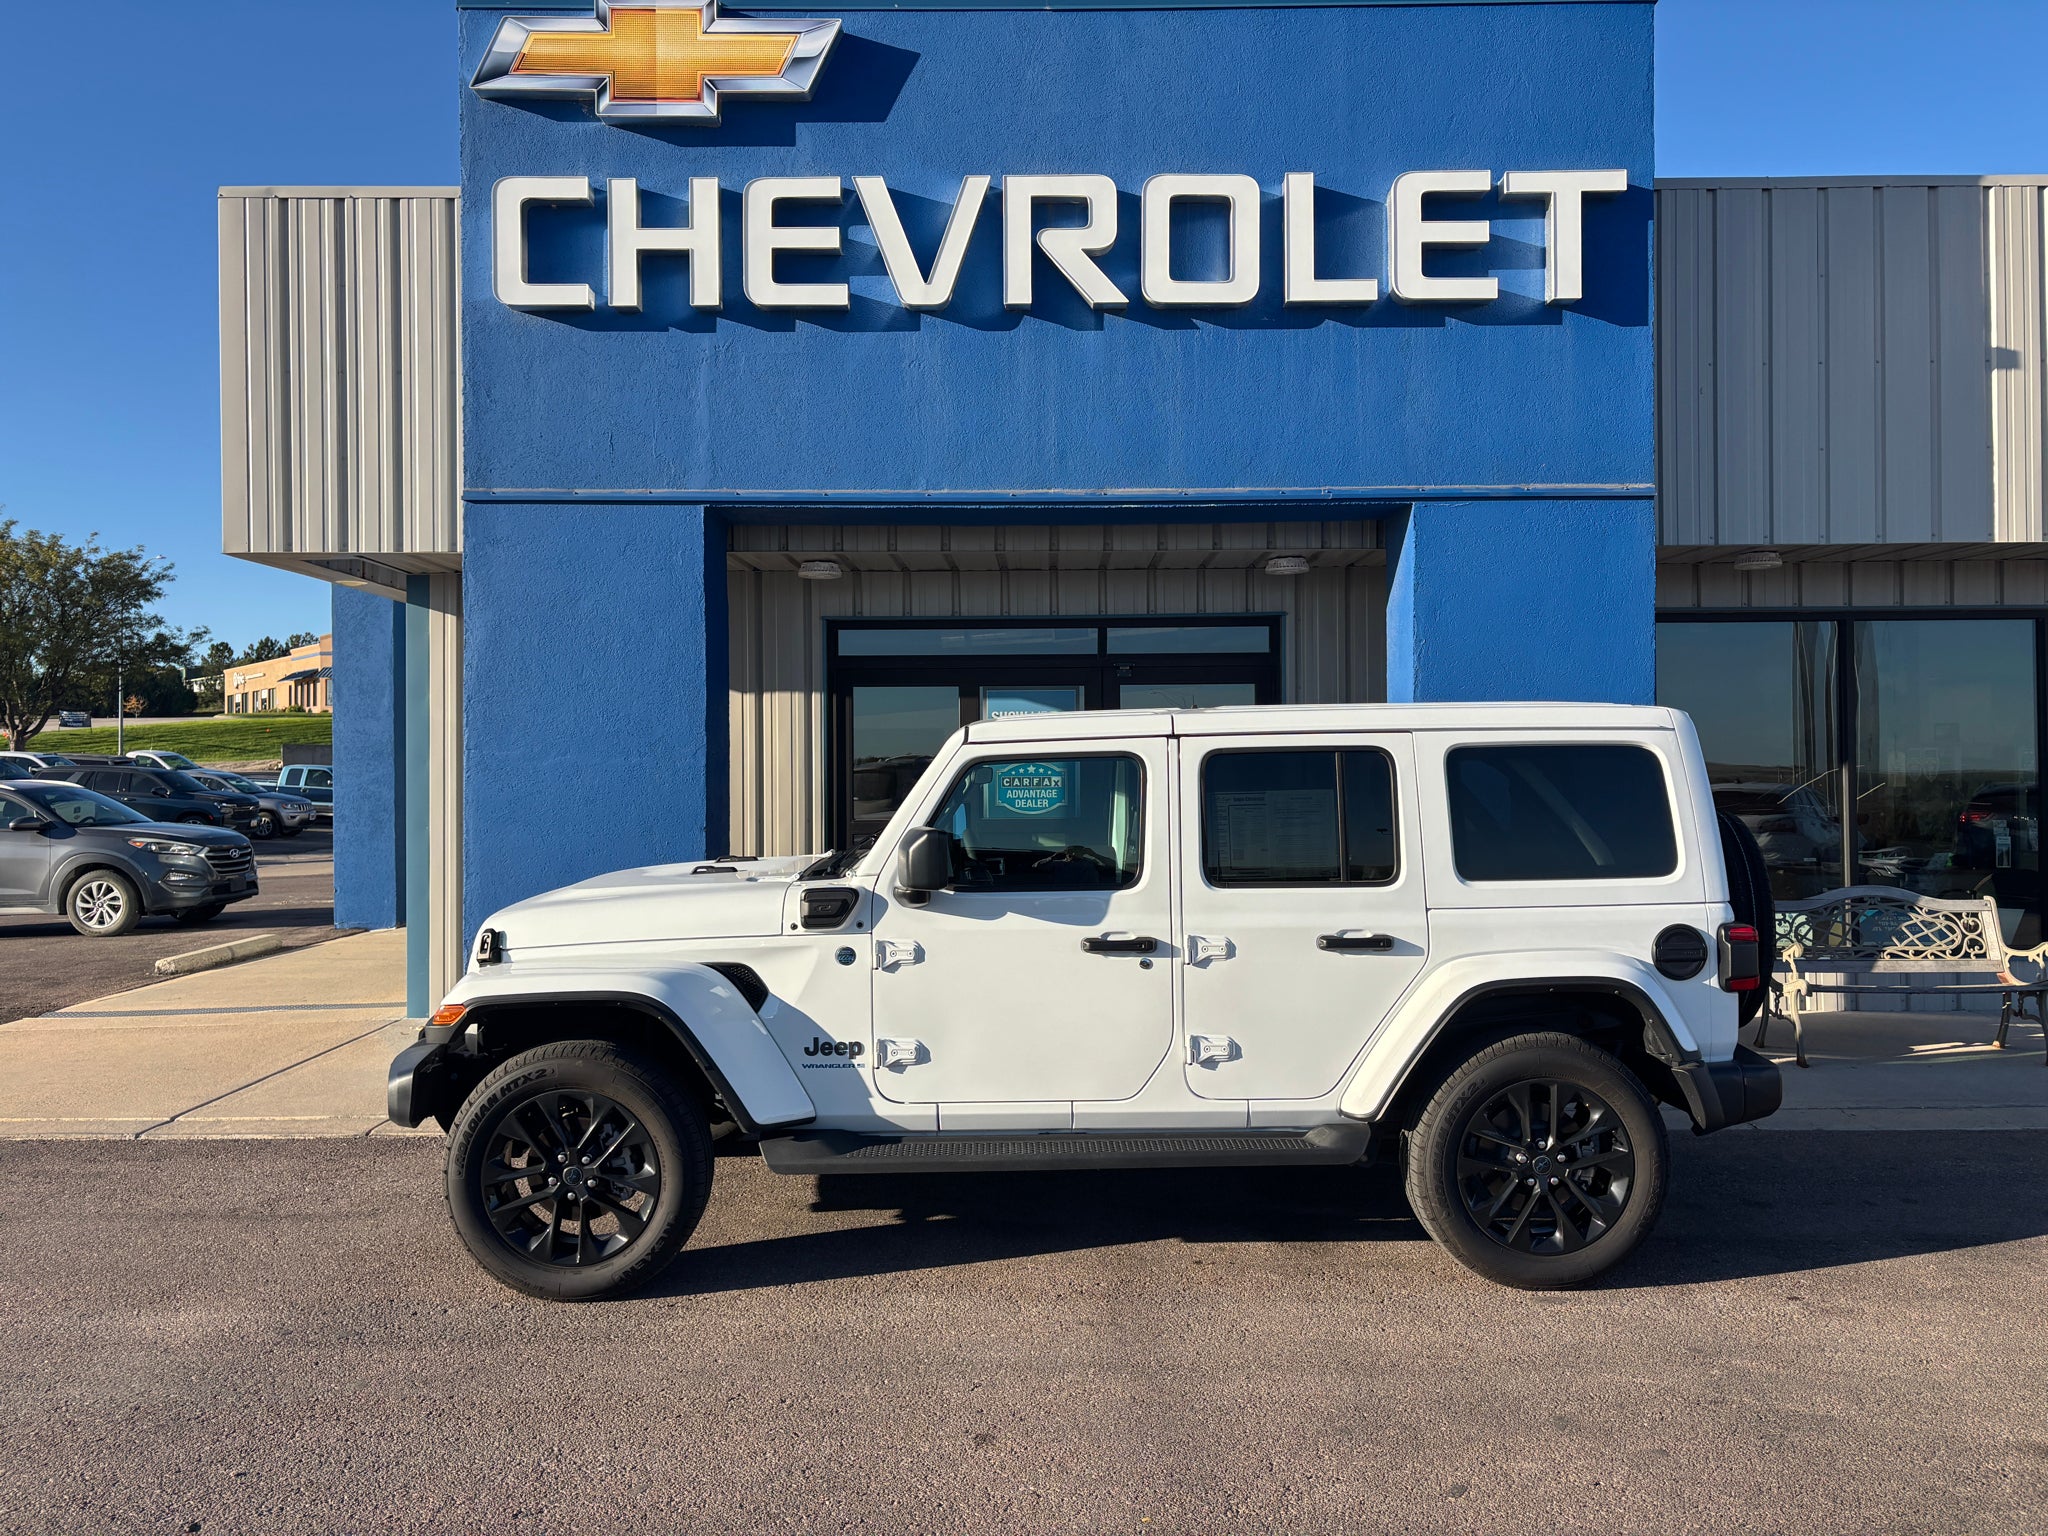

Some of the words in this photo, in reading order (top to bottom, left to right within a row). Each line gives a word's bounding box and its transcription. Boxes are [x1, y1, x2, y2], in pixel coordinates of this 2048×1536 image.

[492, 168, 1629, 311] CHEVROLET
[1002, 777, 1061, 788] CARFAX
[1006, 789, 1058, 799] ADVANTAGE
[1015, 799, 1049, 808] DEALER
[803, 1036, 865, 1060] Jeep
[455, 1093, 499, 1168] ROADIAN
[500, 1068, 548, 1097] HTX2
